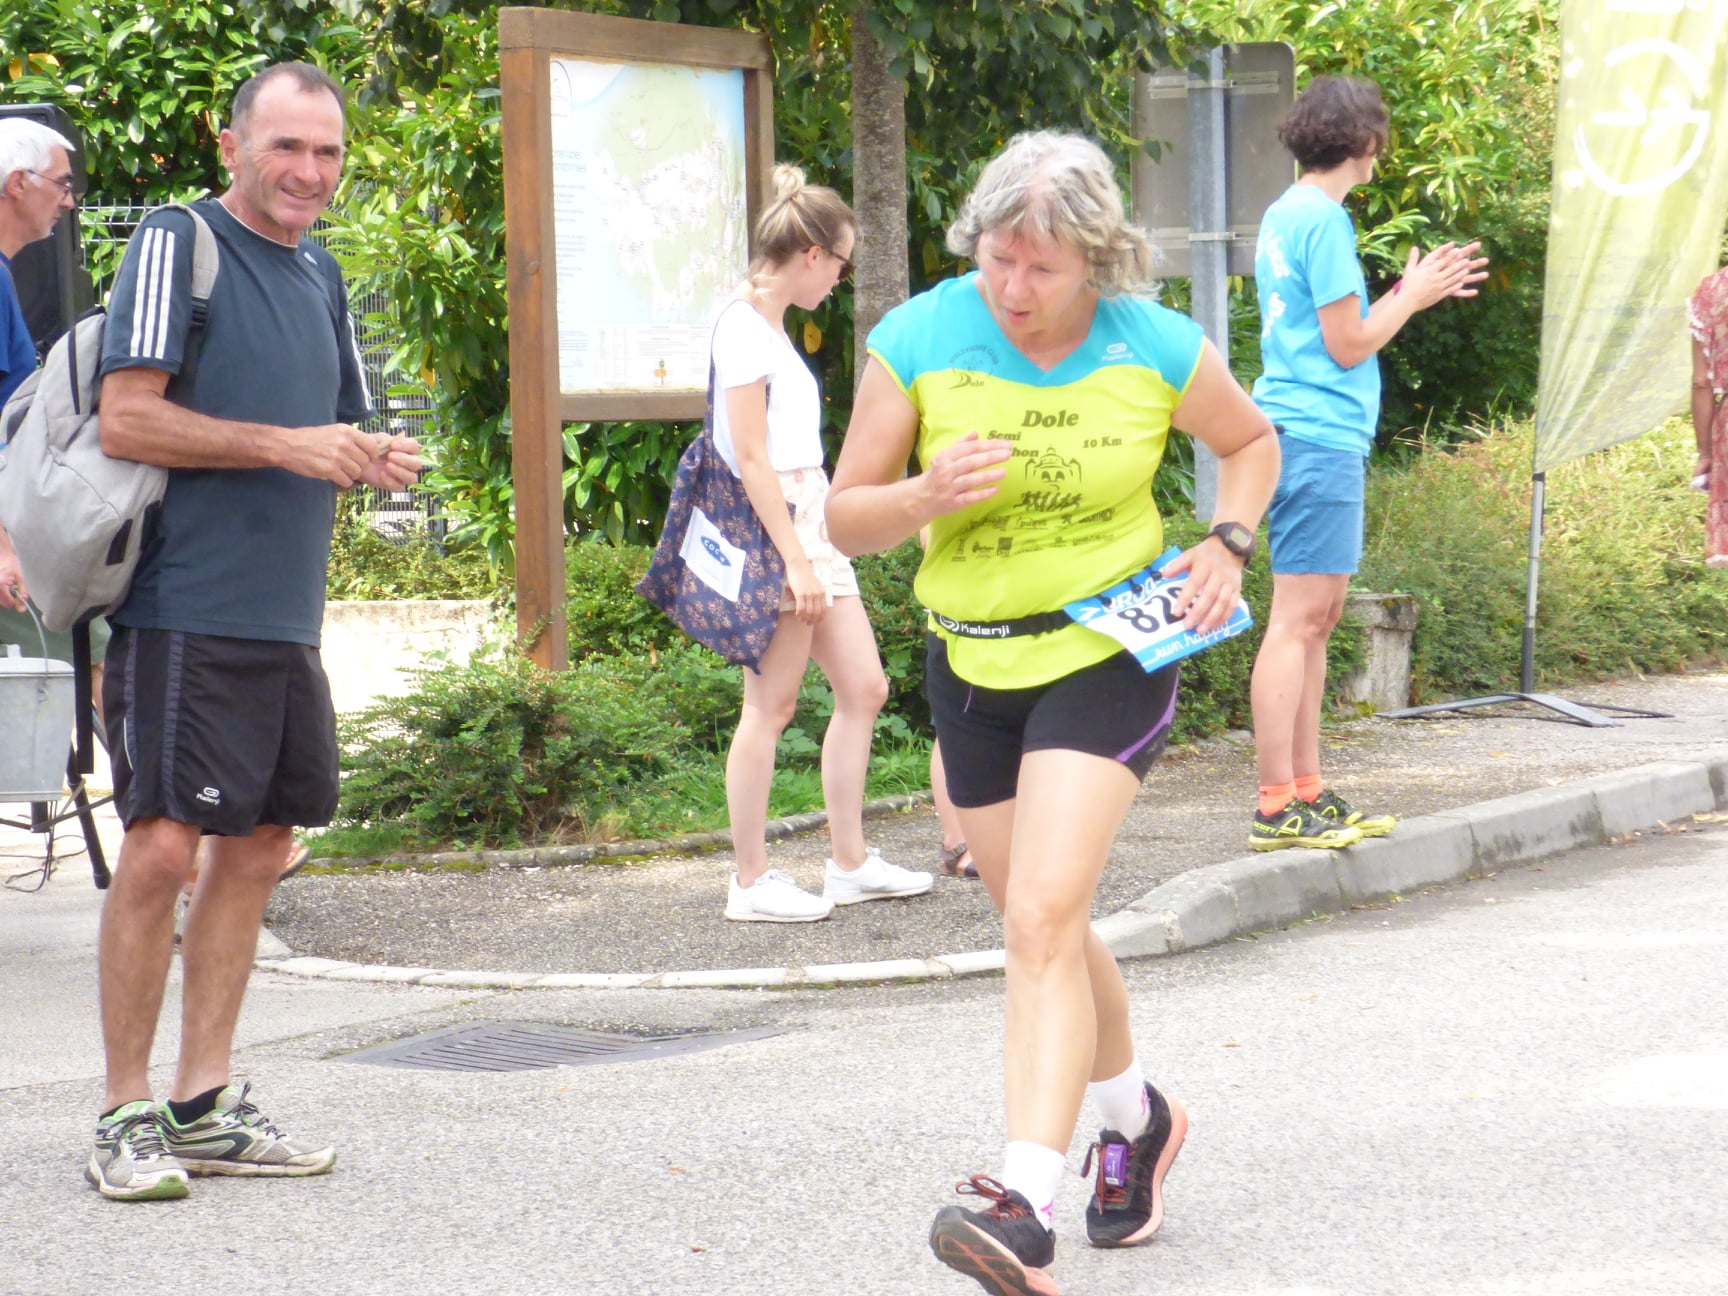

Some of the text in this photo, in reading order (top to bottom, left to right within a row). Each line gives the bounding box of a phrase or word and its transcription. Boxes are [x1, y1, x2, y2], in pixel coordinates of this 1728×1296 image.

[1021, 409, 1079, 428] Dole
[987, 429, 1022, 441] Semi
[1083, 436, 1122, 449] 10 Km
[960, 622, 1010, 638] Kalenji
[1253, 821, 1277, 833] SCOTT
